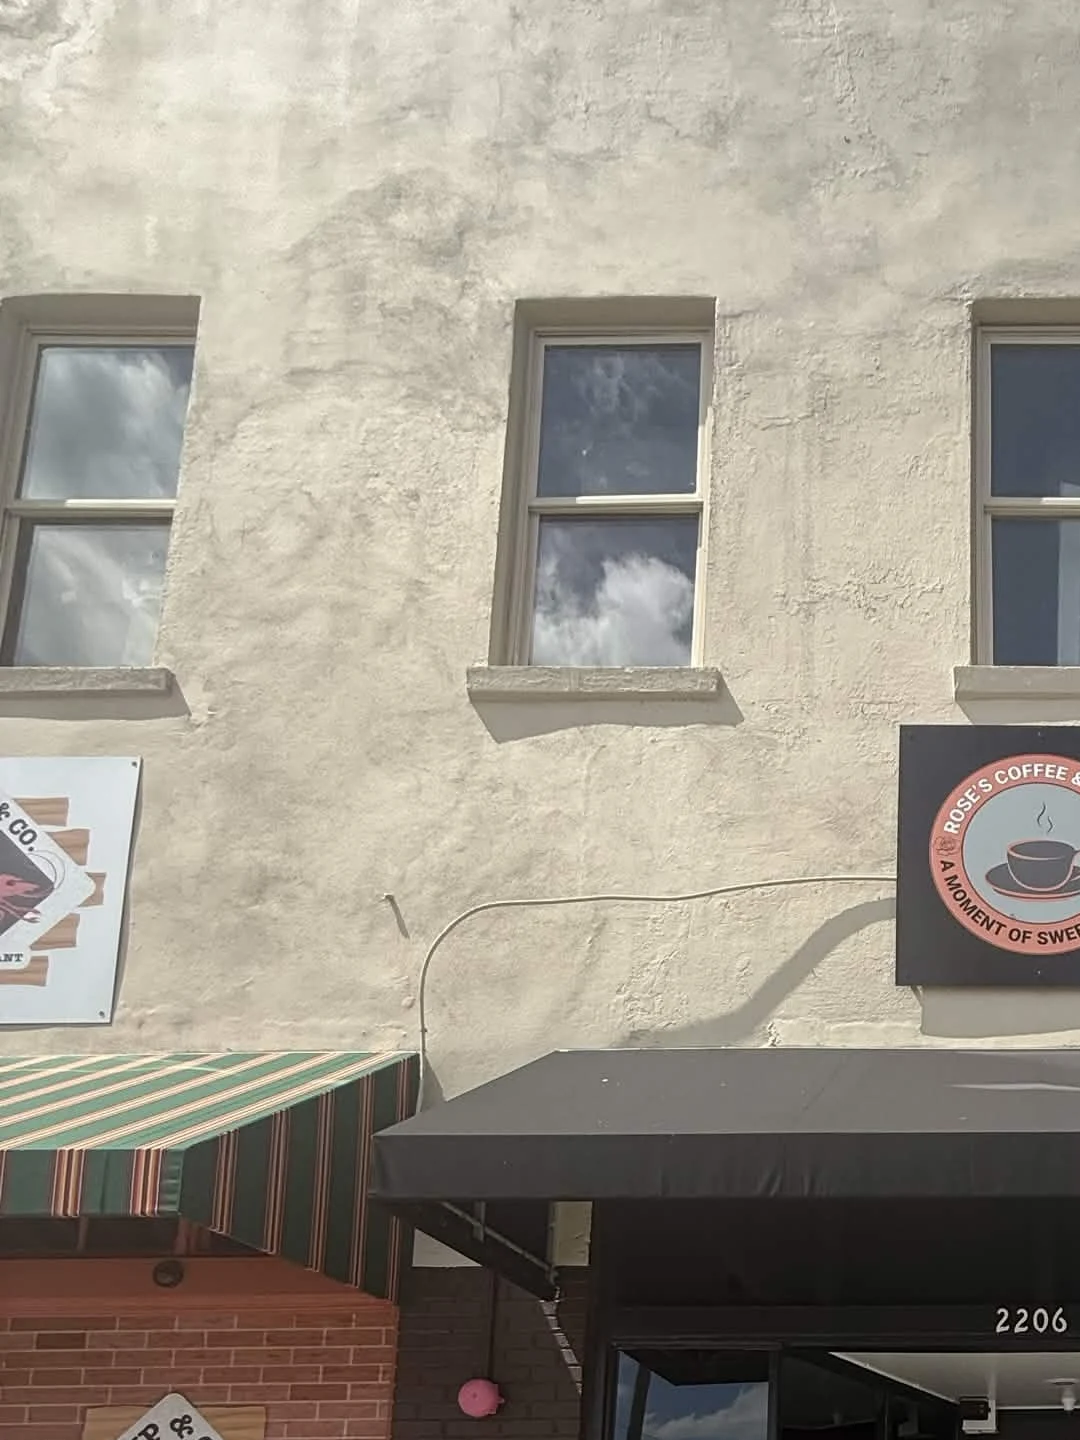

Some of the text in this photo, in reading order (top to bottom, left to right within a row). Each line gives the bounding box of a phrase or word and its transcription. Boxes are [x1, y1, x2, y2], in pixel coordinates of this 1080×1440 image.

[944, 778, 993, 835] ROSE'S
[994, 763, 1069, 786] COFFEE
[9, 818, 38, 852] CO.
[940, 860, 954, 872] A
[944, 875, 1006, 936] MOMENT
[1008, 928, 1032, 945] OF
[995, 1307, 1068, 1333] 2206
[169, 1414, 194, 1439] &
